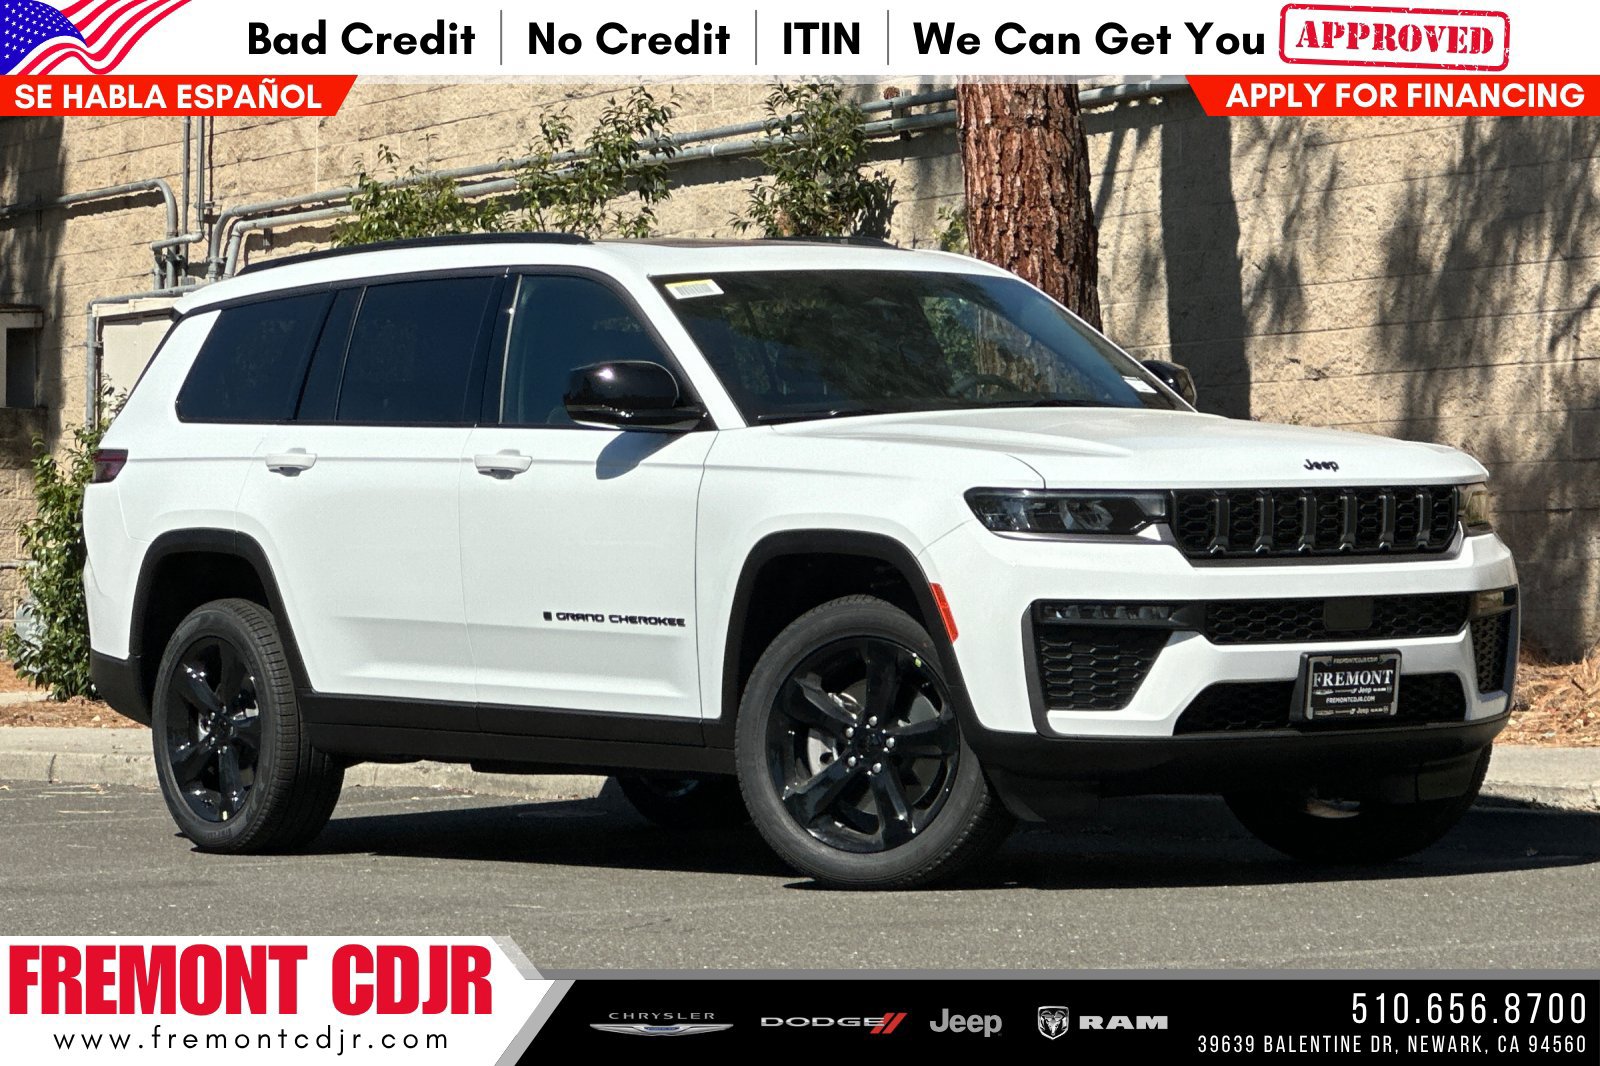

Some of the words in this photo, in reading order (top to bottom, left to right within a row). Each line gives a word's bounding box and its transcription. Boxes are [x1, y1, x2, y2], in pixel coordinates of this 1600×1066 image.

[1303, 458, 1339, 472] Jeep
[555, 612, 605, 623] GRAND
[608, 614, 686, 627] CHEROKEE
[1313, 669, 1393, 687] FREMONT
